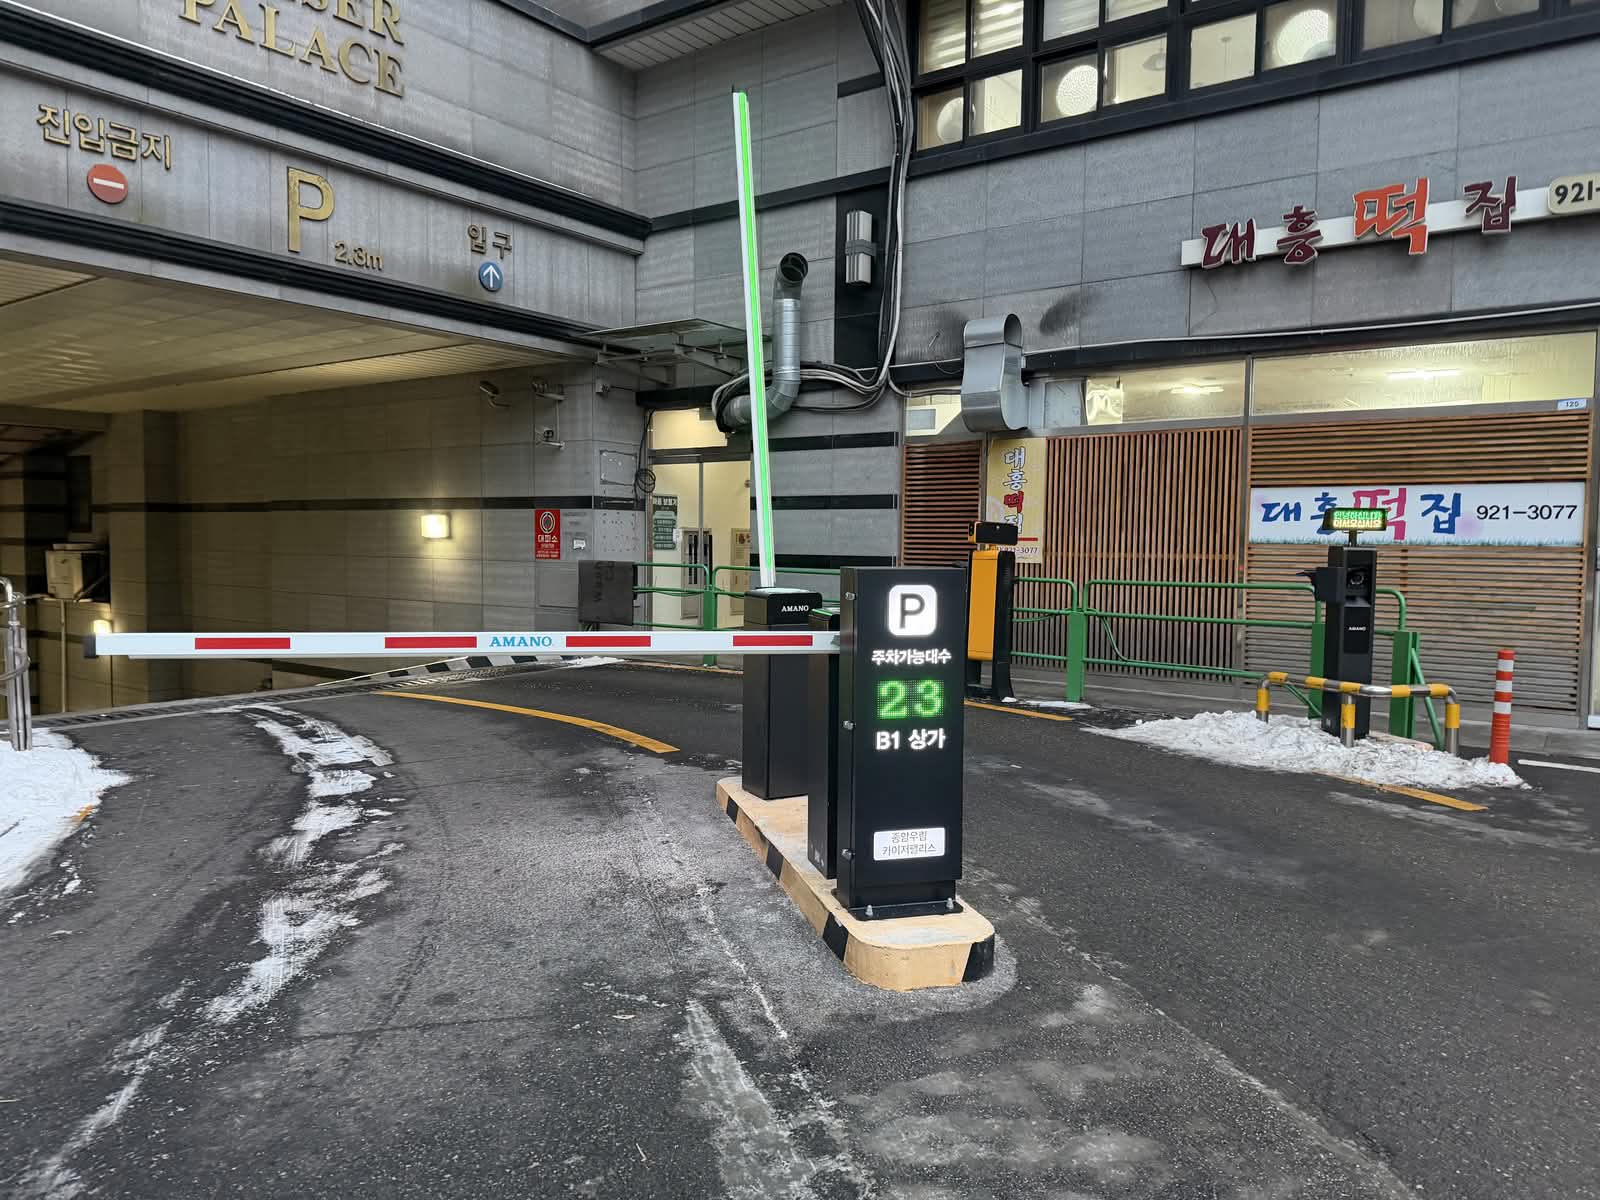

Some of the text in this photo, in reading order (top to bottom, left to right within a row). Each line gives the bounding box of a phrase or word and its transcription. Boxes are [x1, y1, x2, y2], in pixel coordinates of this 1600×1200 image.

[179, 0, 403, 98] PALACE
[37, 103, 172, 170] 진입금지
[287, 166, 335, 253] P
[335, 240, 384, 271] 2.3m
[1475, 503, 1578, 521] 921-3077
[489, 636, 553, 647] AMANO
[871, 648, 952, 666] 주차가능대수
[878, 680, 943, 719] 23
[876, 727, 946, 750] B1 상가
